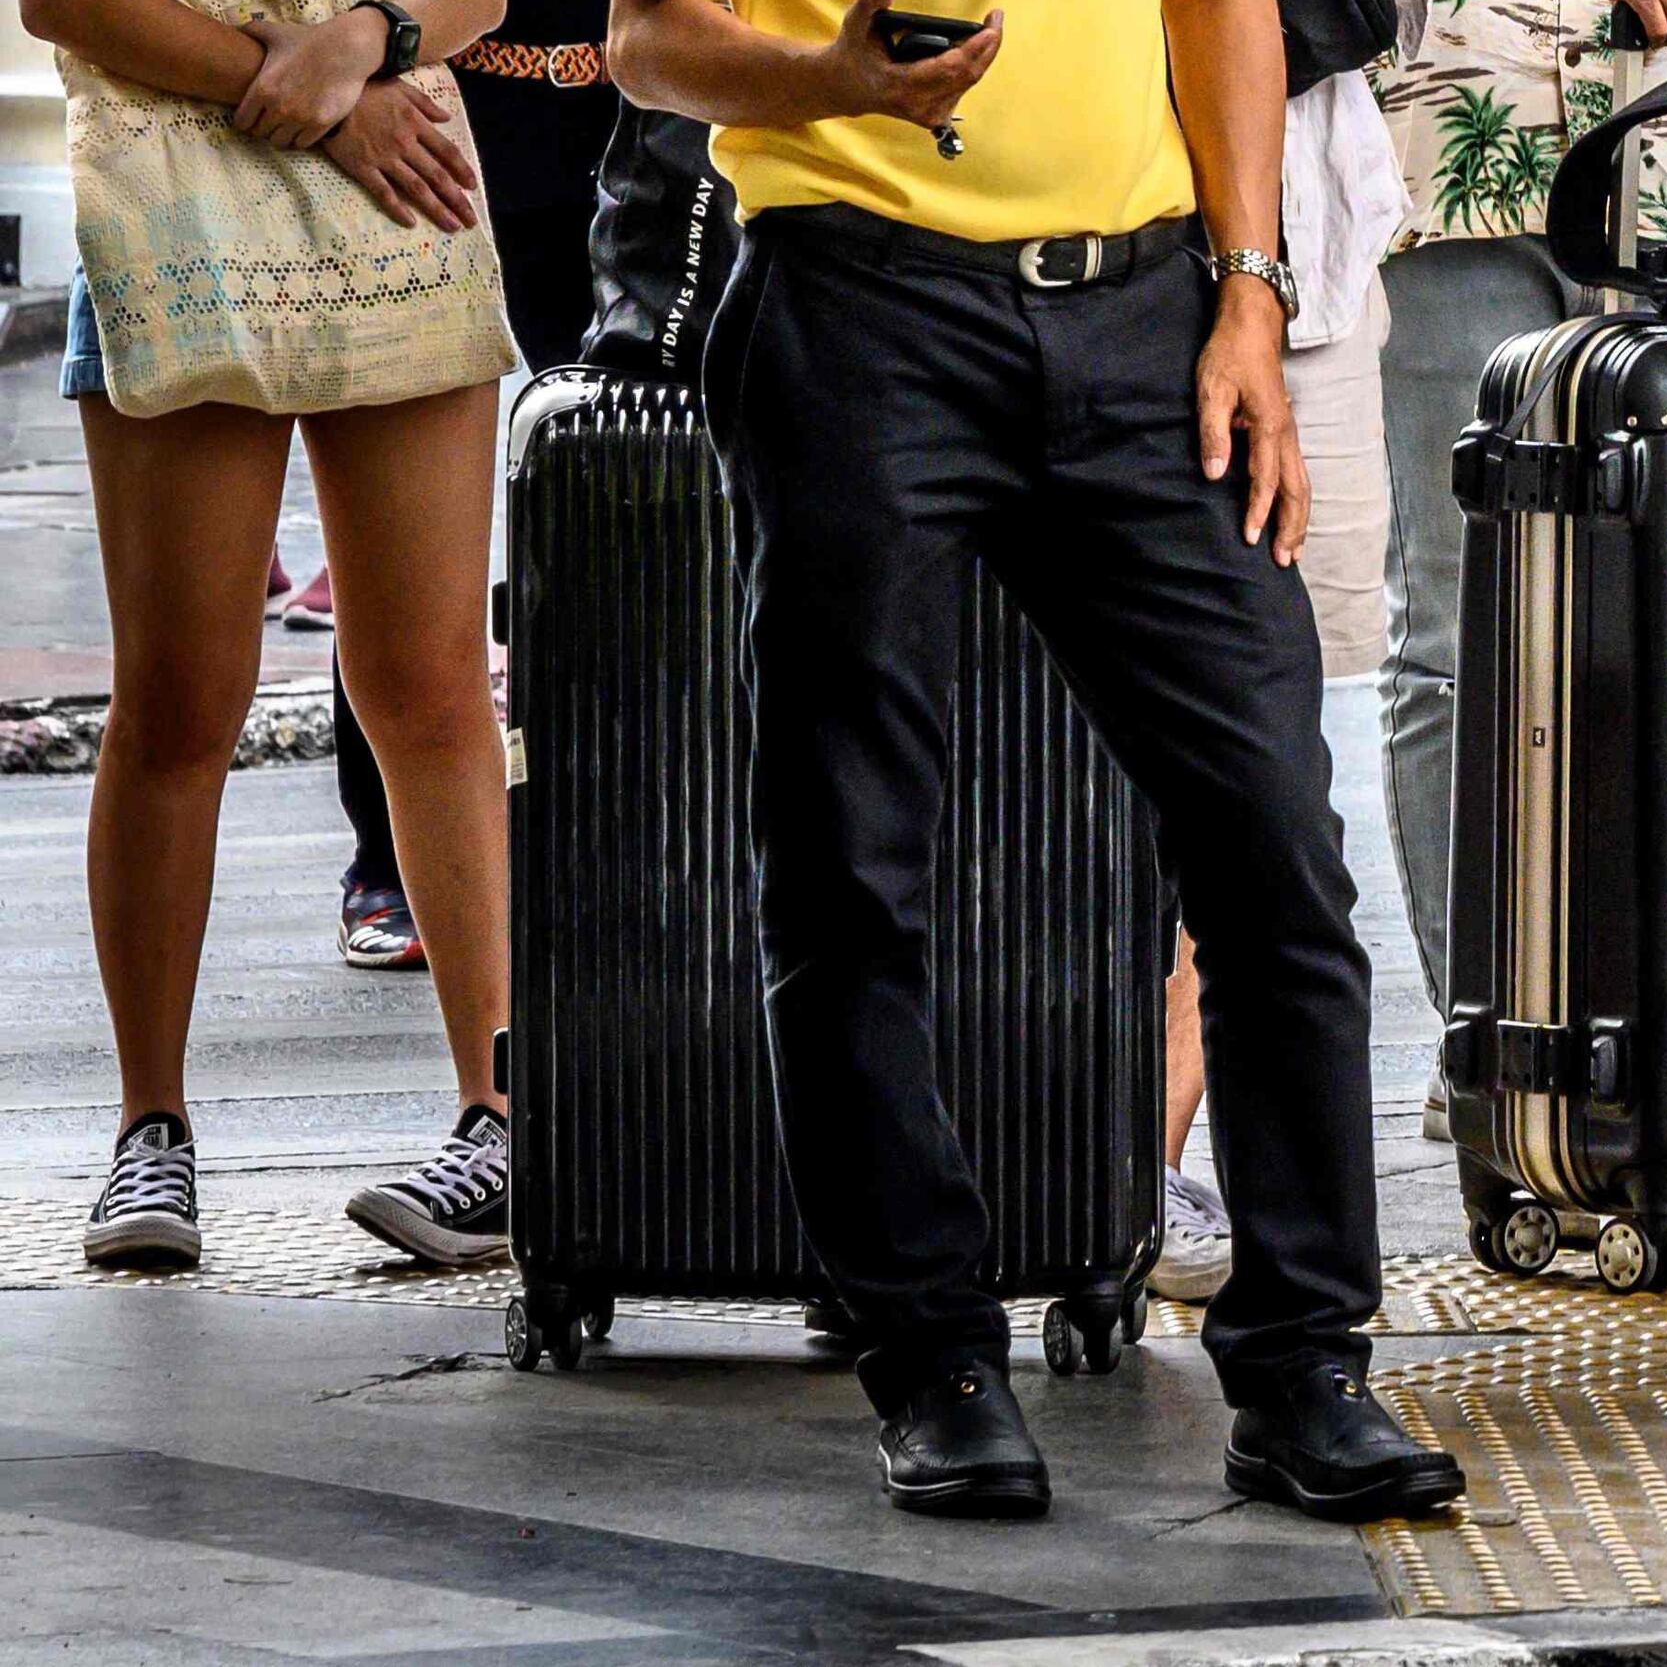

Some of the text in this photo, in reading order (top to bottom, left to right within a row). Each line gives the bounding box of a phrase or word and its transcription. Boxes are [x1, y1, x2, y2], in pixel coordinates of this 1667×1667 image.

[691, 177, 715, 217] DAY
[686, 220, 704, 267] NEW
[676, 287, 695, 307] IS
[685, 271, 698, 284] A
[662, 307, 684, 347] DAY
